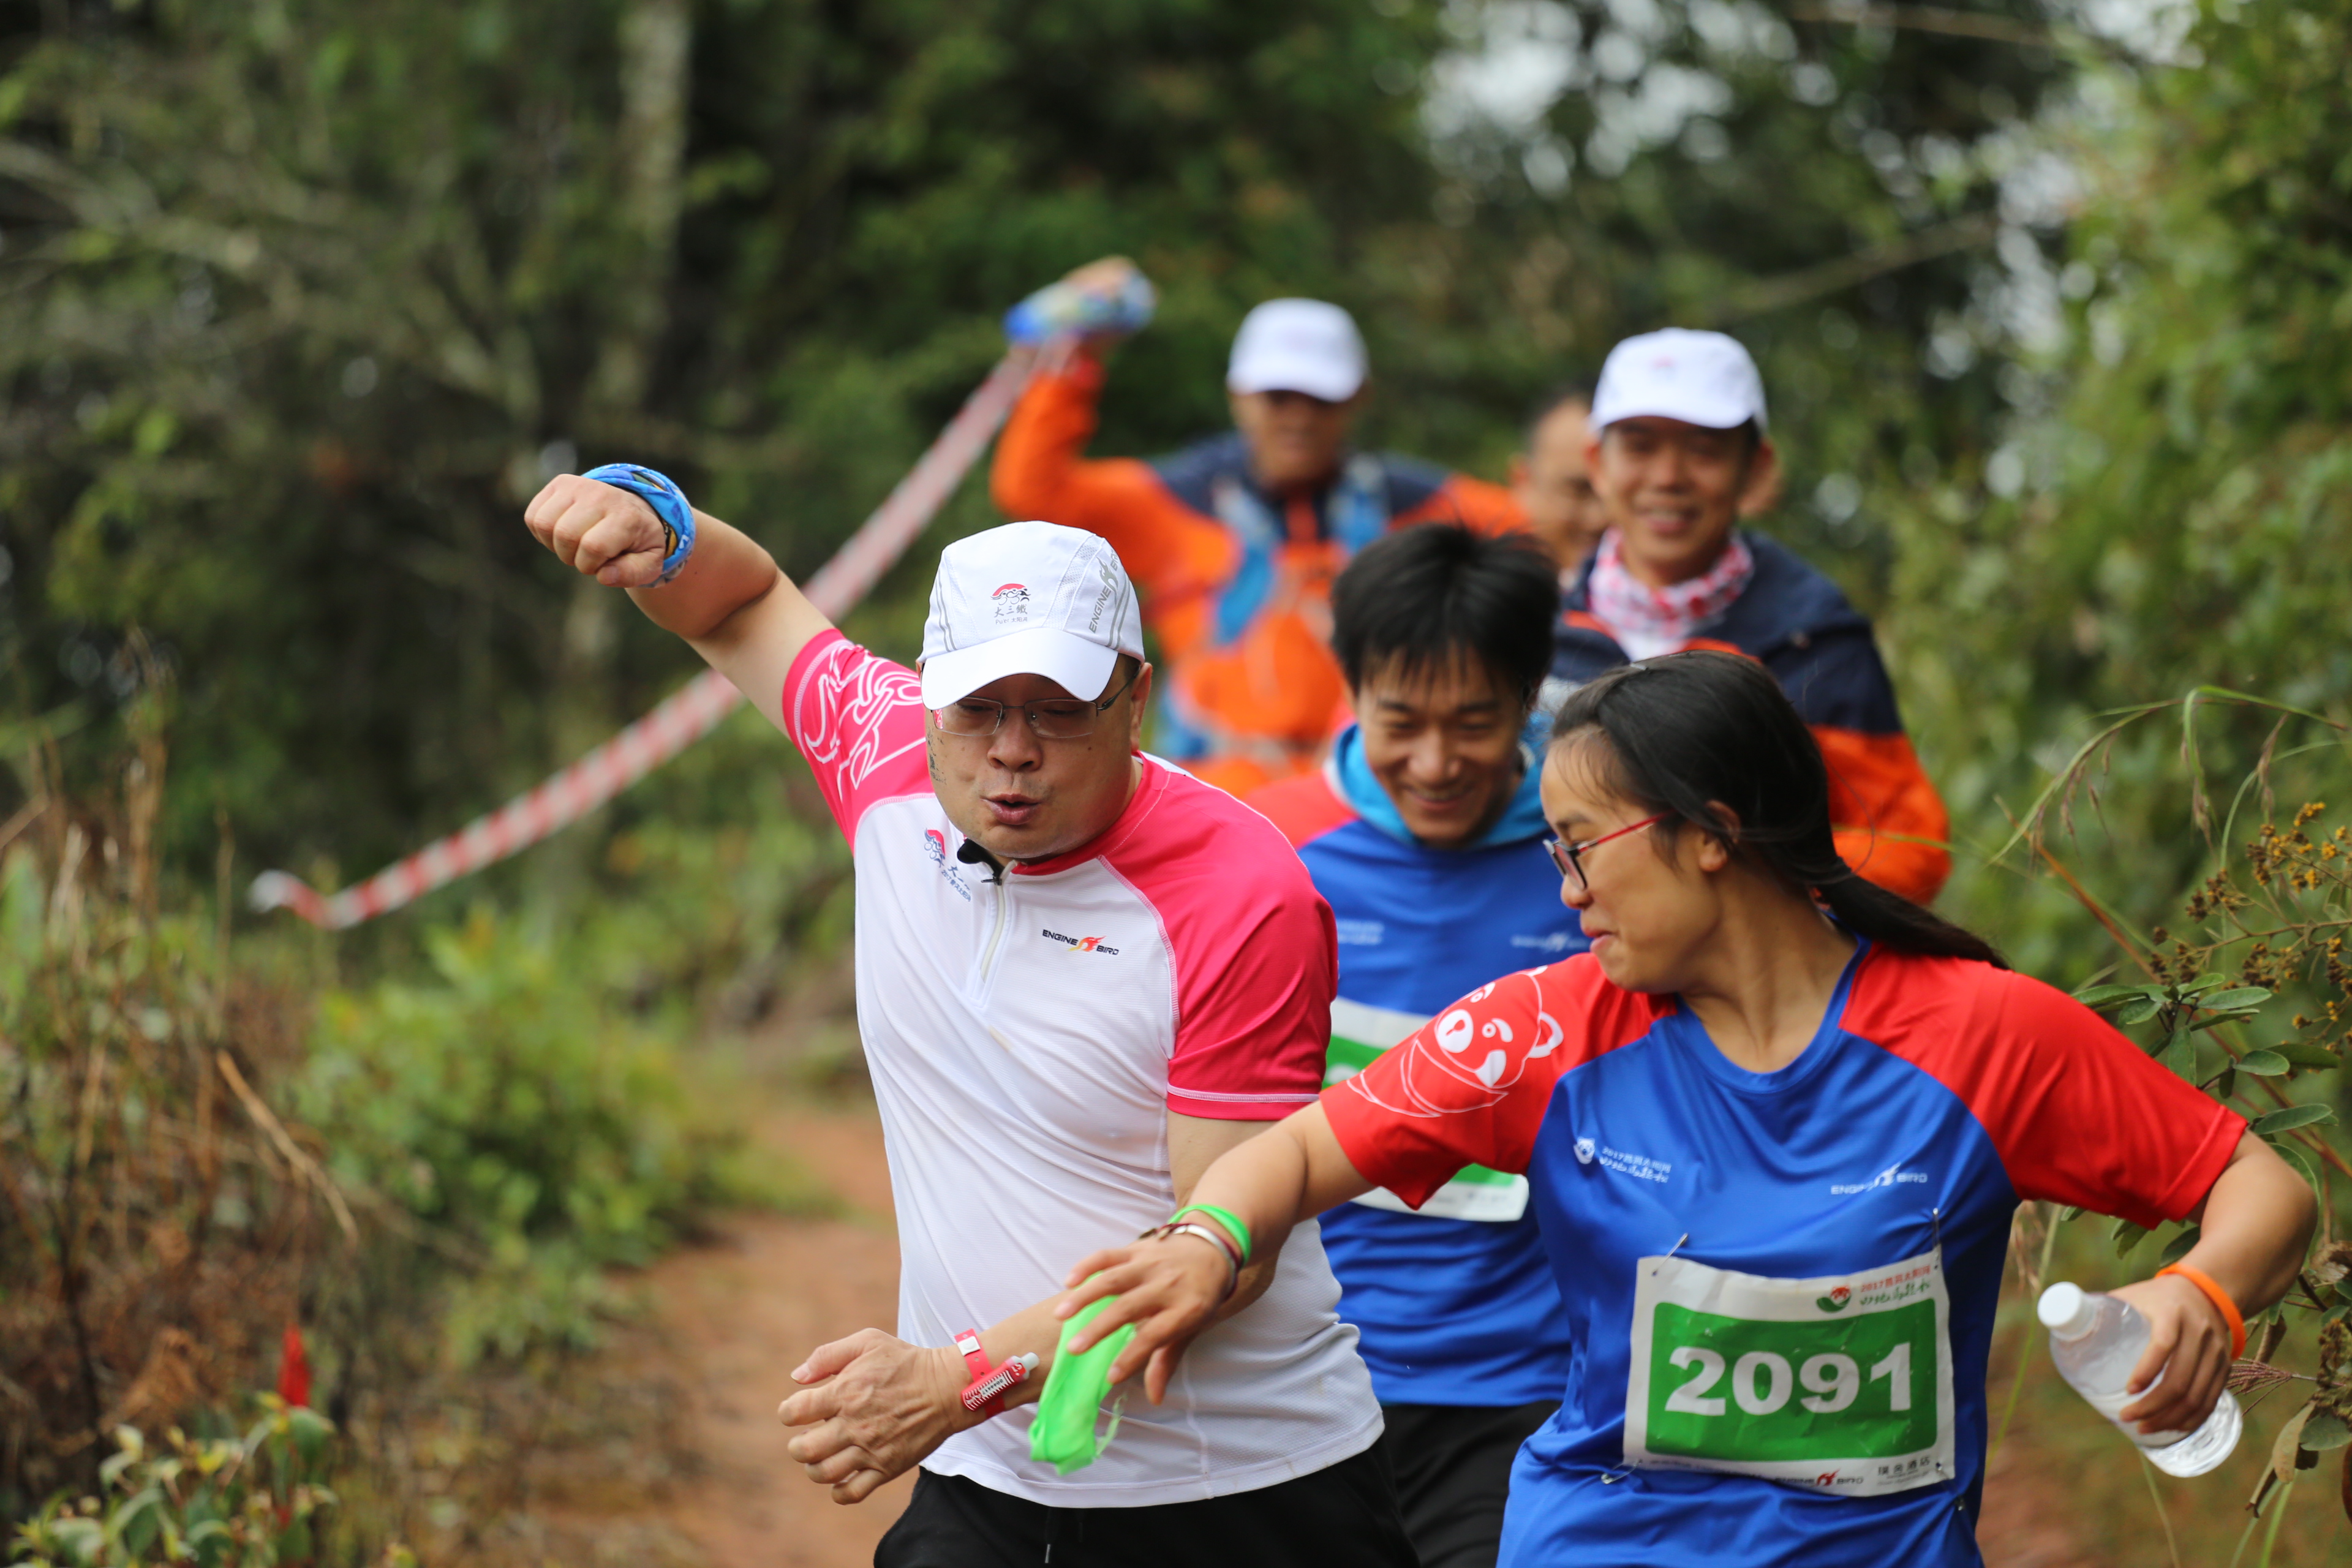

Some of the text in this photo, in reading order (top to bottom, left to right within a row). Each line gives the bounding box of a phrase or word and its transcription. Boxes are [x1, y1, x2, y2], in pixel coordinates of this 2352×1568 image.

[1089, 585, 1111, 634] ENGINE
[1042, 929, 1119, 956] ENGINE BIRD
[1665, 1342, 1911, 1416] 2091
